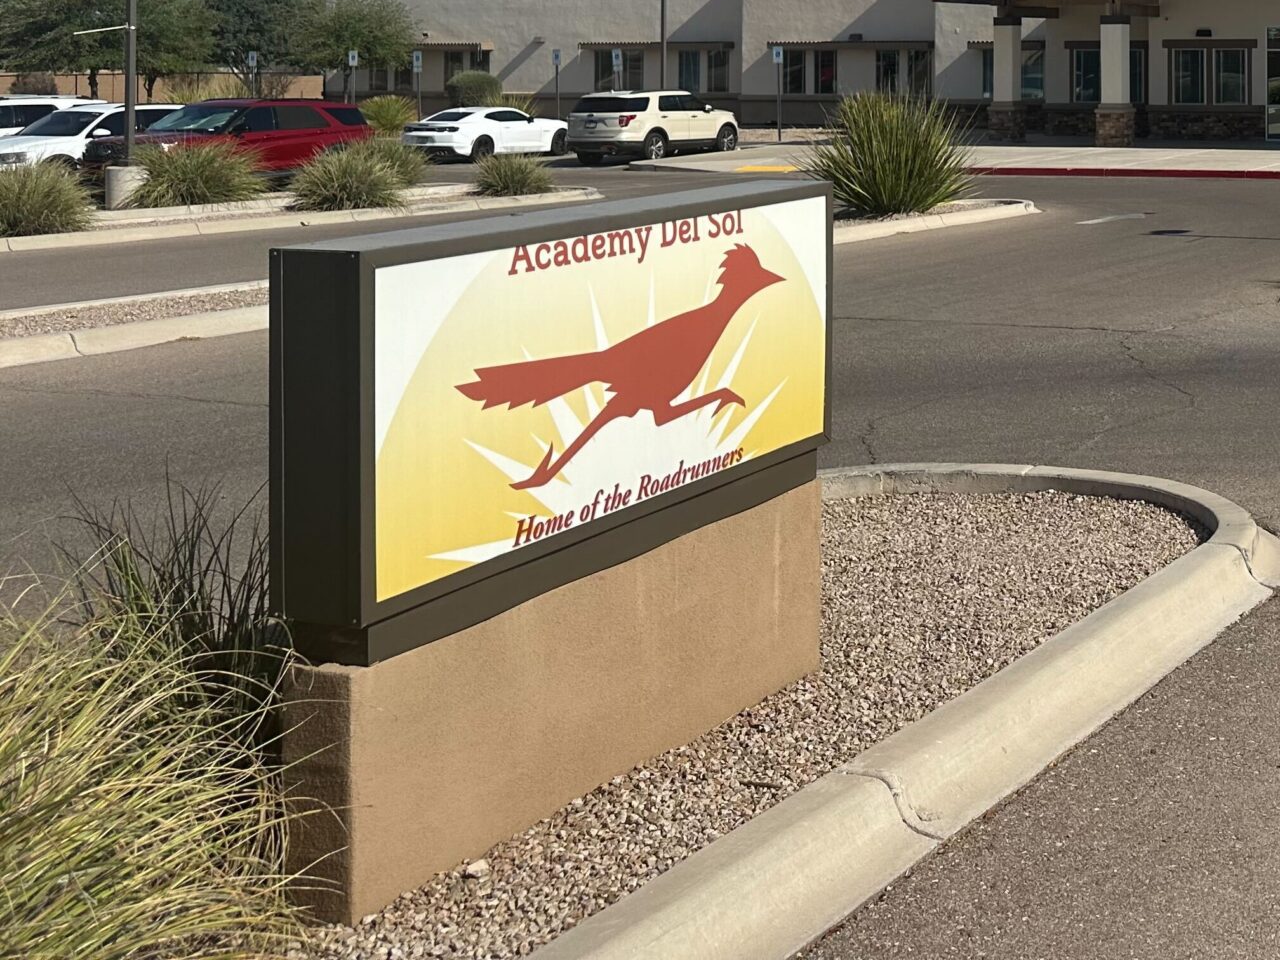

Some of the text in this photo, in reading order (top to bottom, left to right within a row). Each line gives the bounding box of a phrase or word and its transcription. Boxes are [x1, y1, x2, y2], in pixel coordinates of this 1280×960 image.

[508, 209, 744, 275] Academy Del Sol
[512, 447, 744, 548] Home of the Roadrunners
